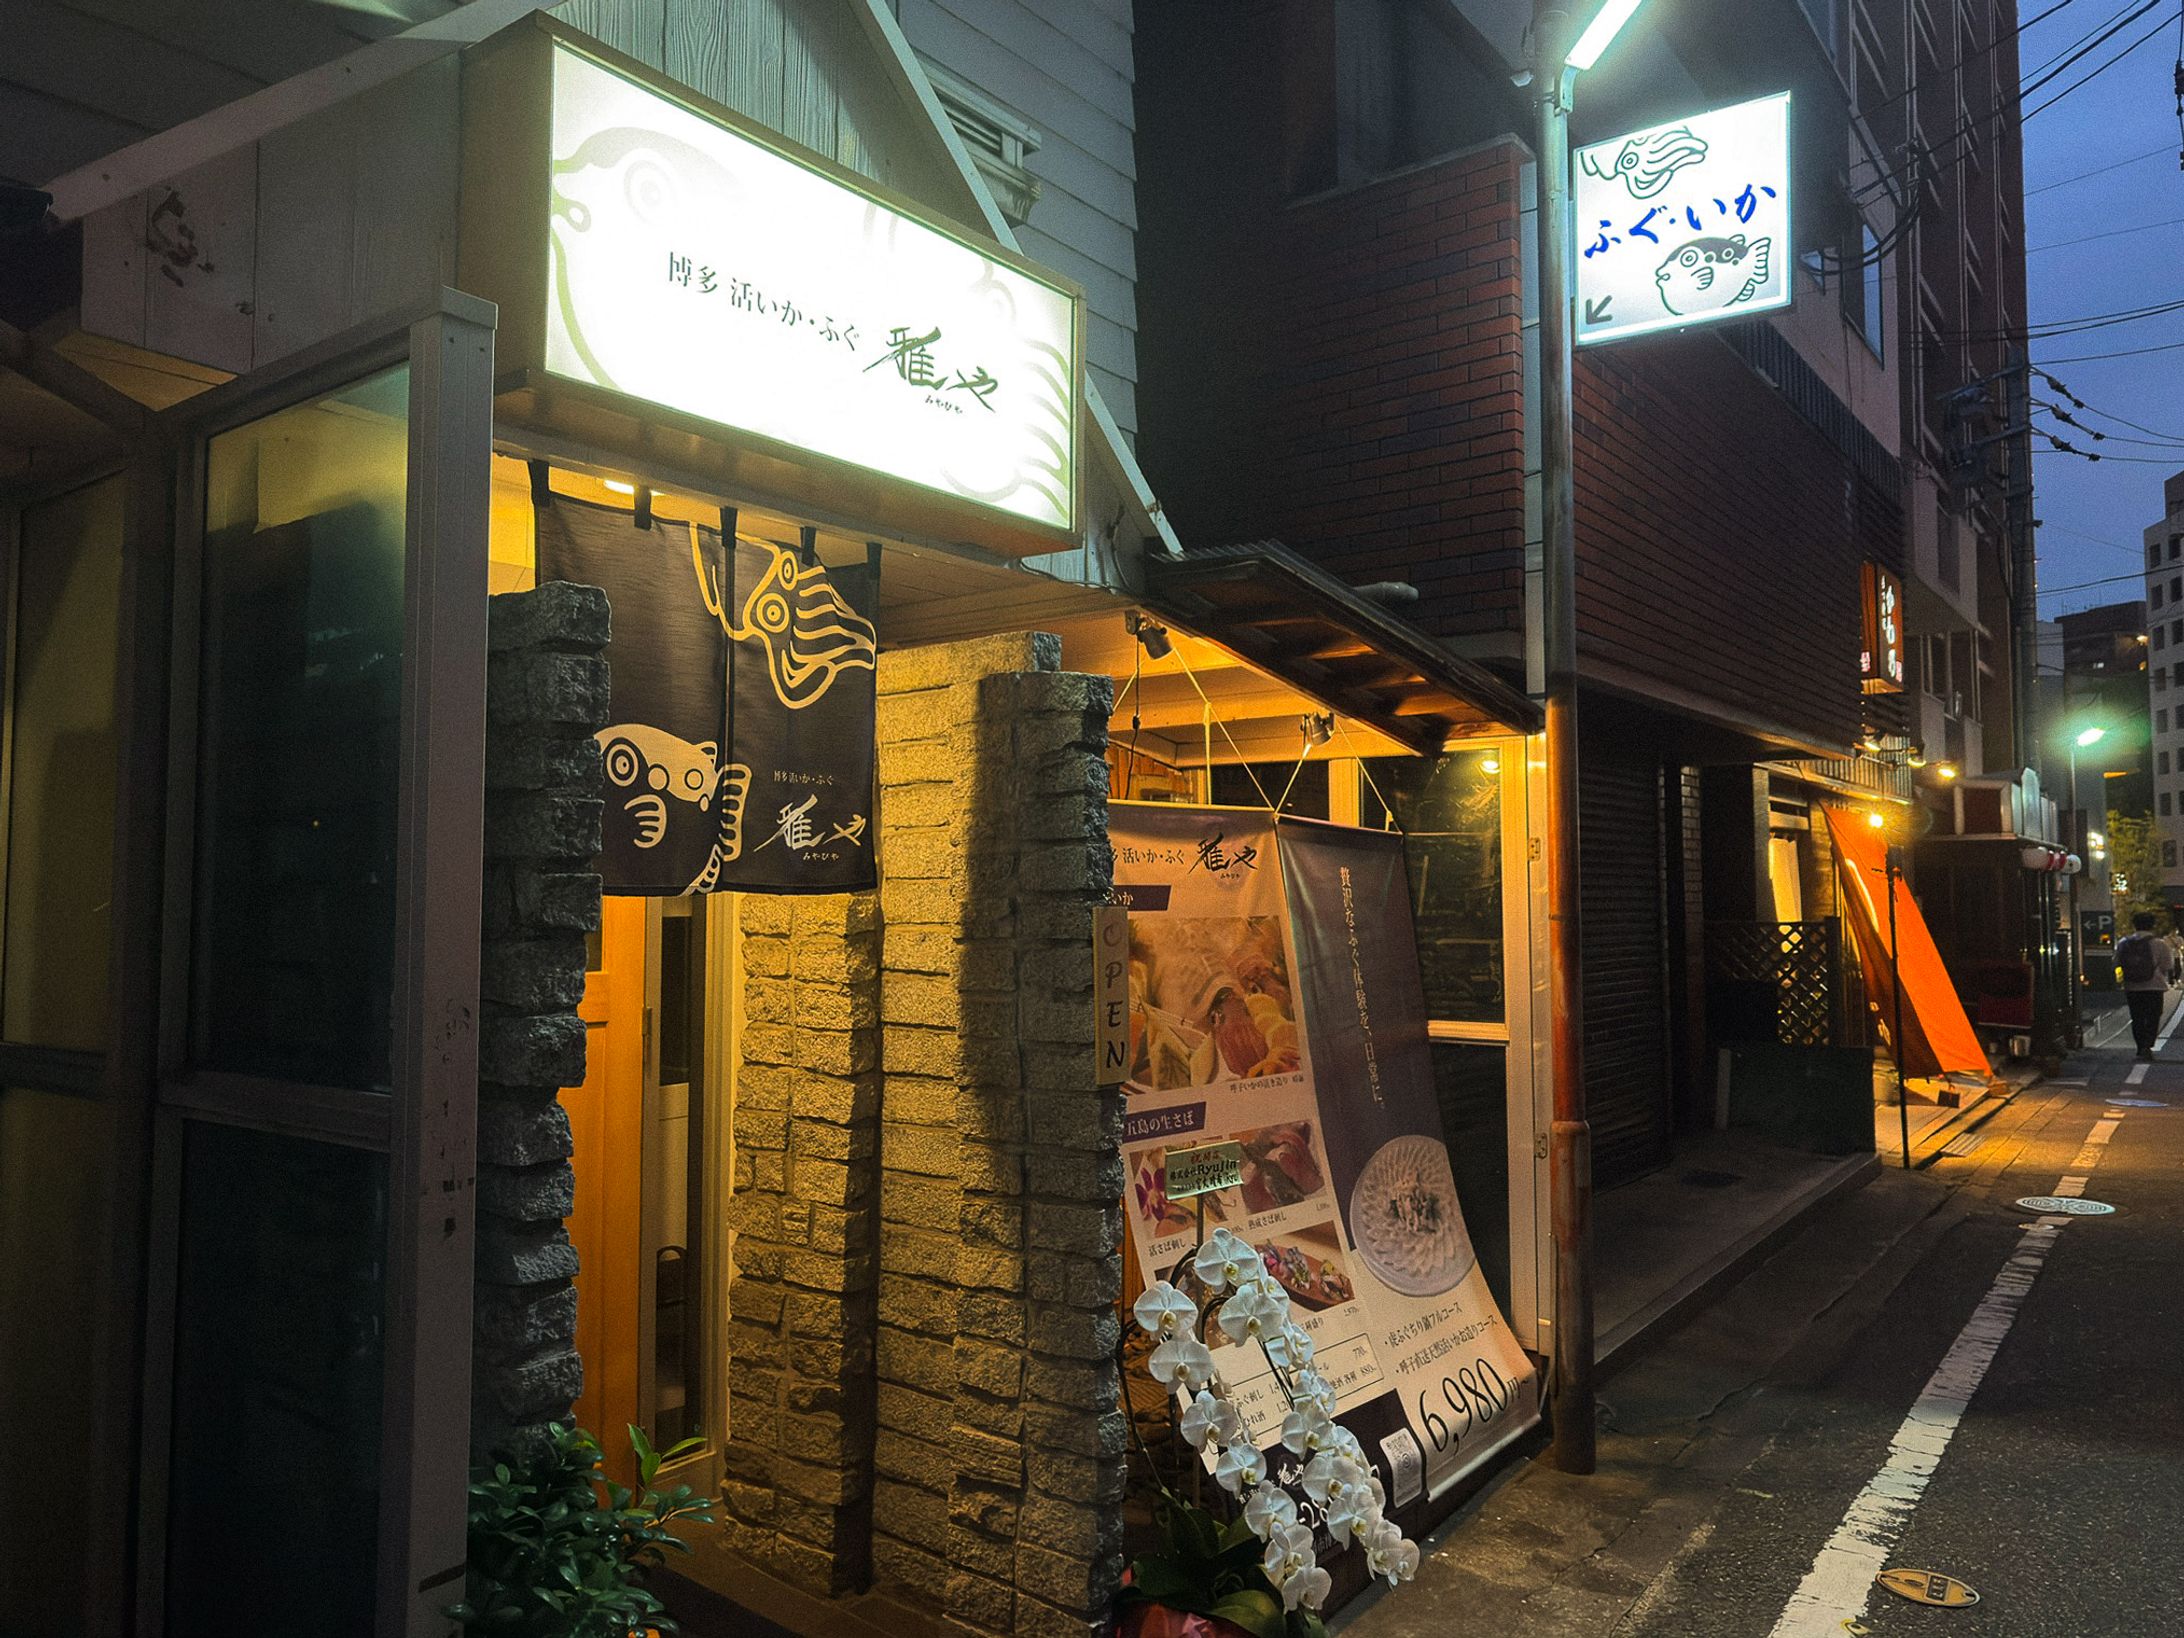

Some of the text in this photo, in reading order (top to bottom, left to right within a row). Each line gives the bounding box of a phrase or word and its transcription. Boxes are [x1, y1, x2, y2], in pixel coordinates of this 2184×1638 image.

[1584, 184, 1777, 259] ふぐ・いか
[862, 326, 999, 413] 雅や
[753, 793, 867, 853] 雅や
[802, 851, 840, 862] みやびや
[1188, 831, 1259, 874] 雅や
[1103, 922, 1125, 1068] OPEN
